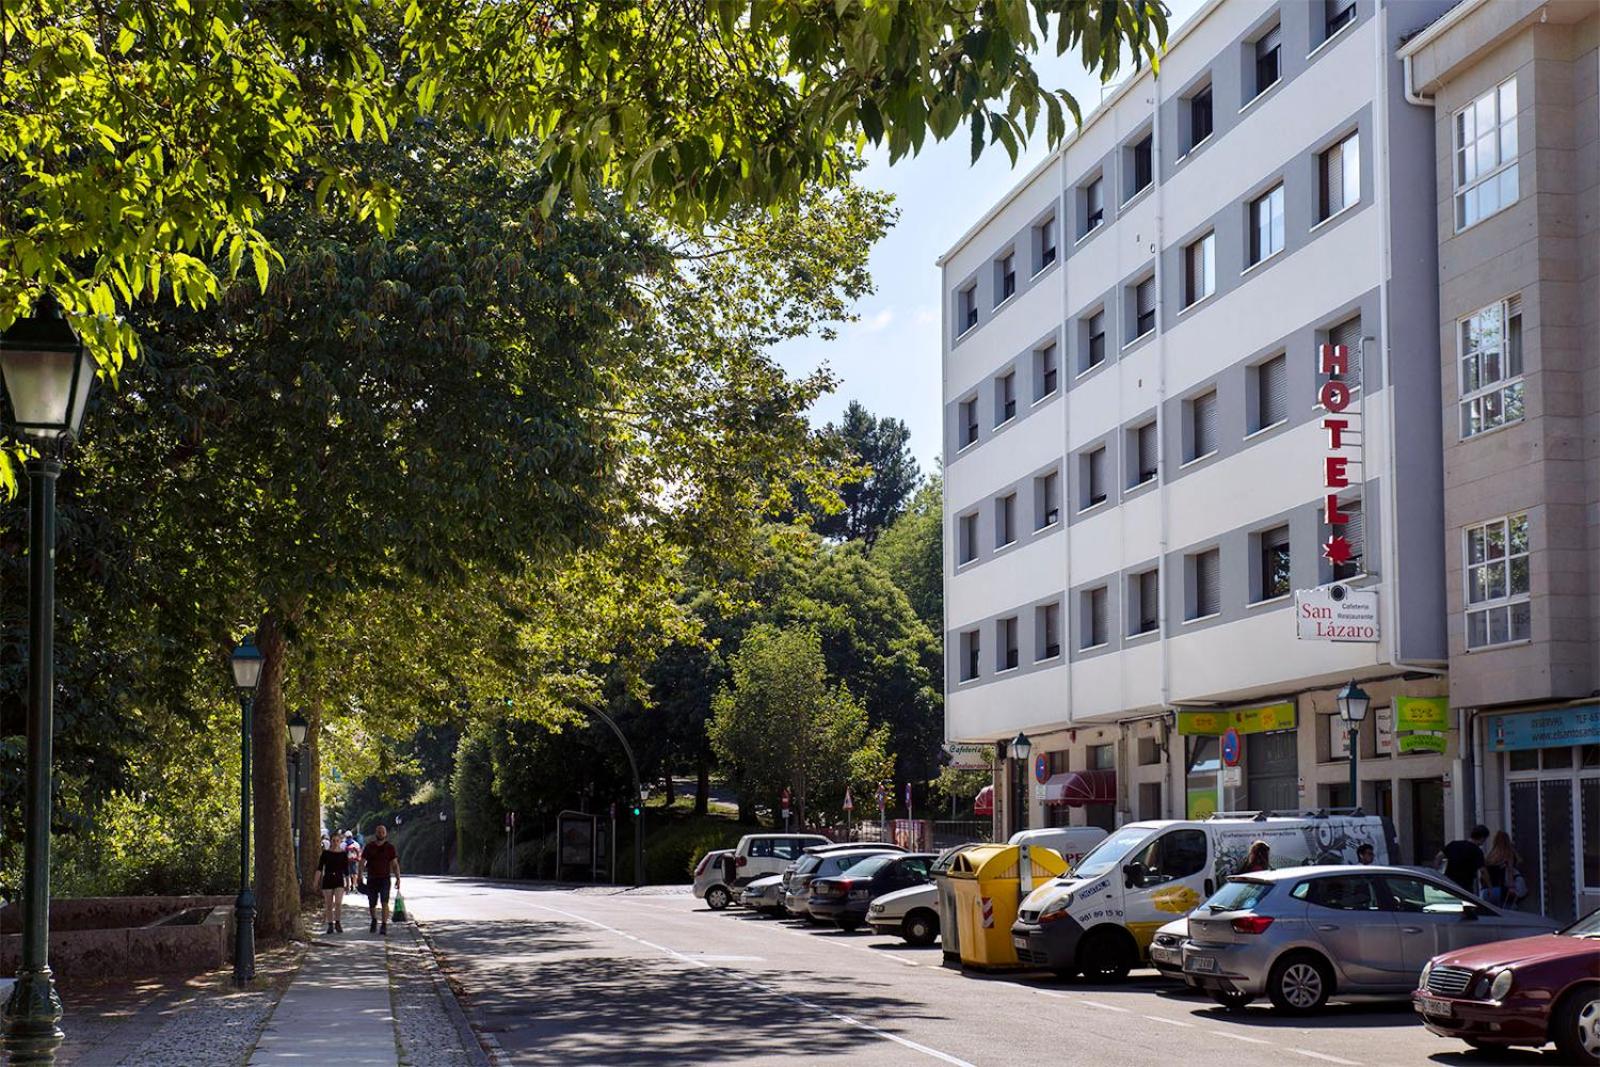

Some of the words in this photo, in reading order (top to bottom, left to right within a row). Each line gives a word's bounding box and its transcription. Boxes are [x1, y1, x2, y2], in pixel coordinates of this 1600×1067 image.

[1319, 344, 1349, 524] HOTEL
[1302, 603, 1331, 619] San
[1316, 621, 1374, 638] Lázaro
